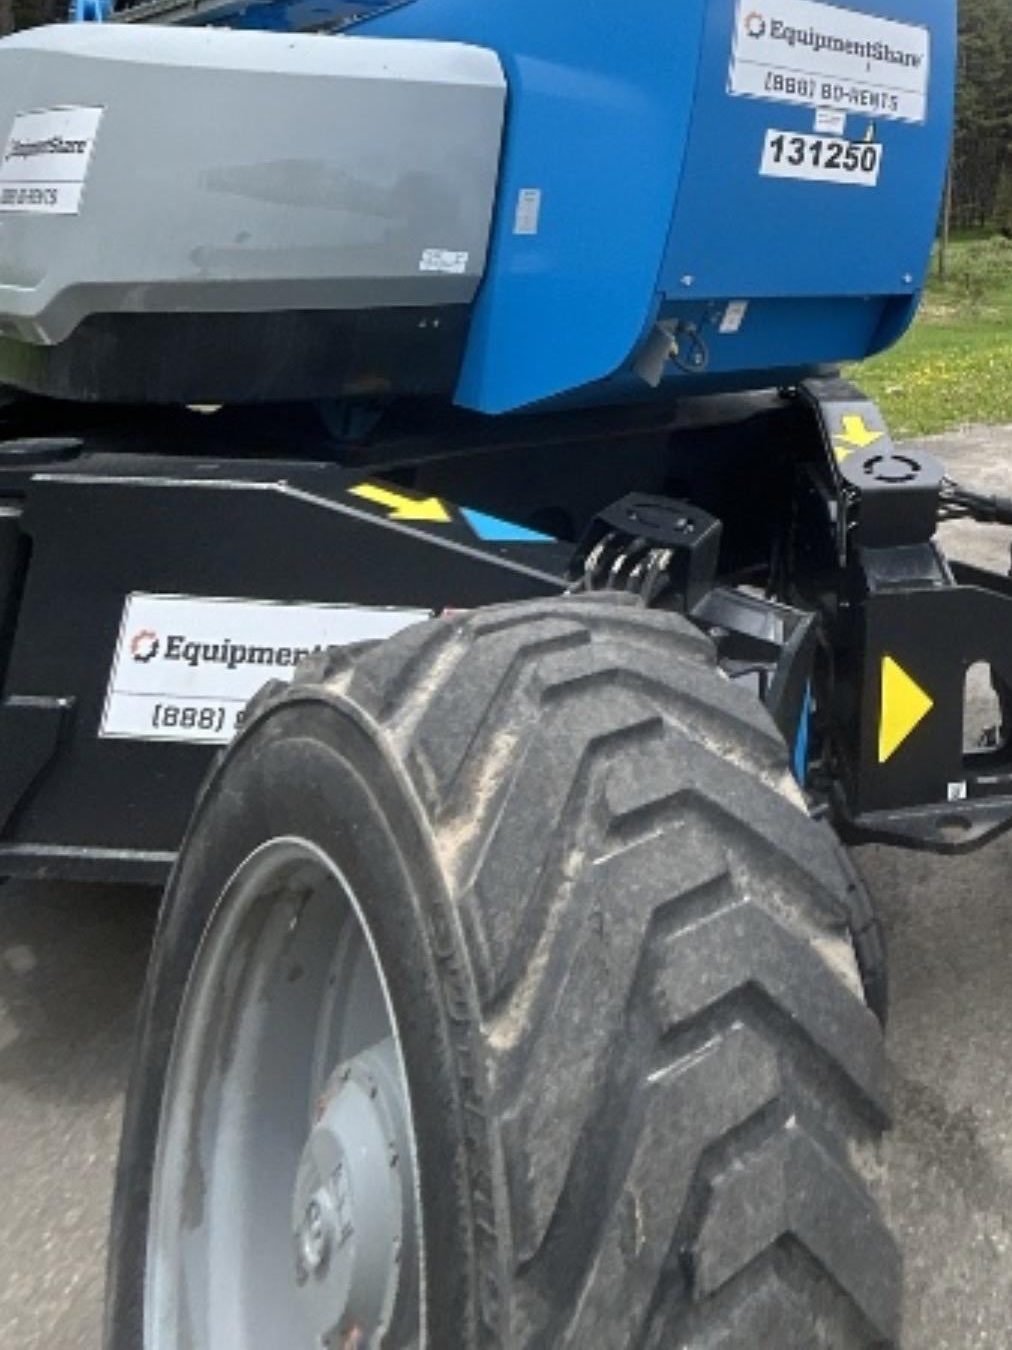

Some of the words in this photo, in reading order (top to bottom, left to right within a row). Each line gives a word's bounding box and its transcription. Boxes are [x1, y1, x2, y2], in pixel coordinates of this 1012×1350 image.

[769, 17, 922, 69] EquipmentShare
[770, 135, 877, 172] 131250
[164, 635, 321, 669] Equipmen
